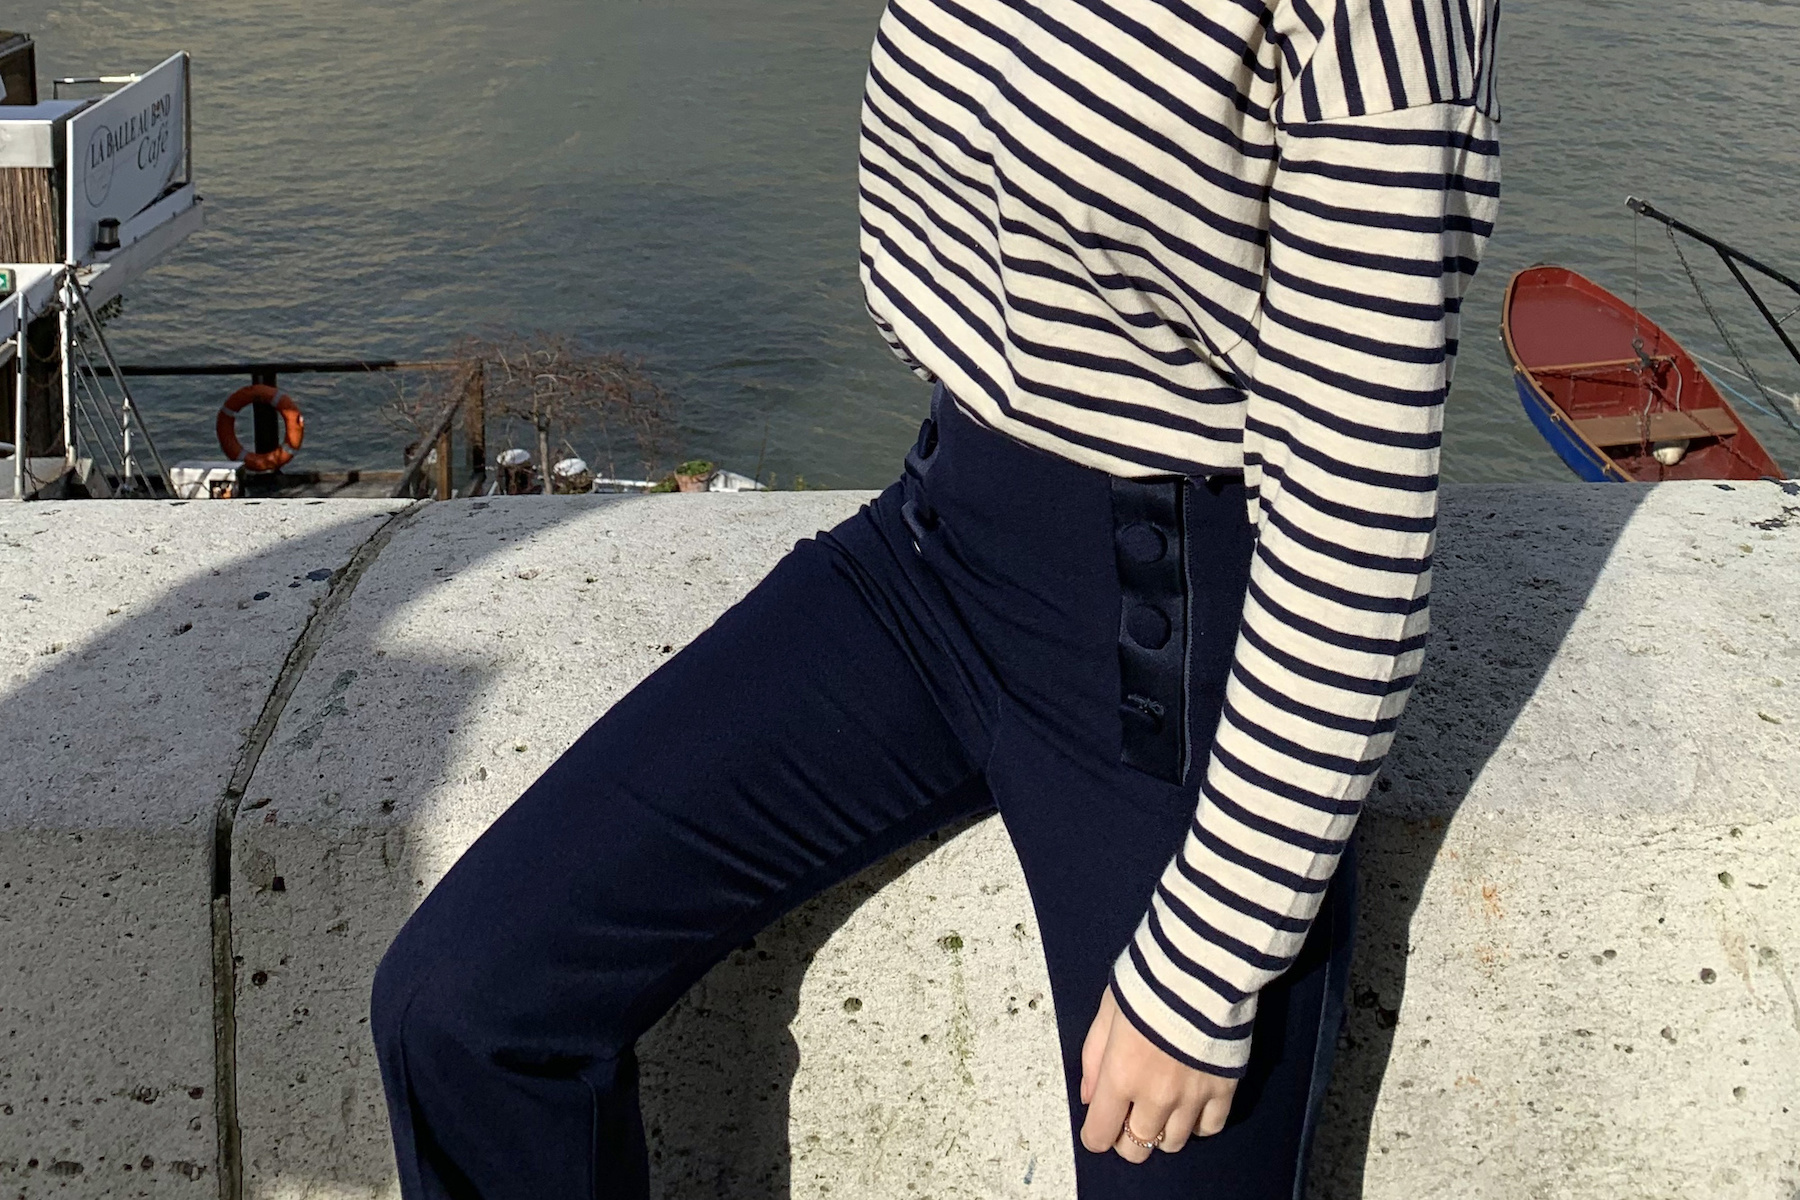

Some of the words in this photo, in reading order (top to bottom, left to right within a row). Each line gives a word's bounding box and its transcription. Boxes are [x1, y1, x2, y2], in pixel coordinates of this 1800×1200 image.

[91, 139, 104, 169] LA
[107, 117, 136, 158] BALLE
[138, 106, 150, 136] AU
[138, 121, 169, 170] Café
